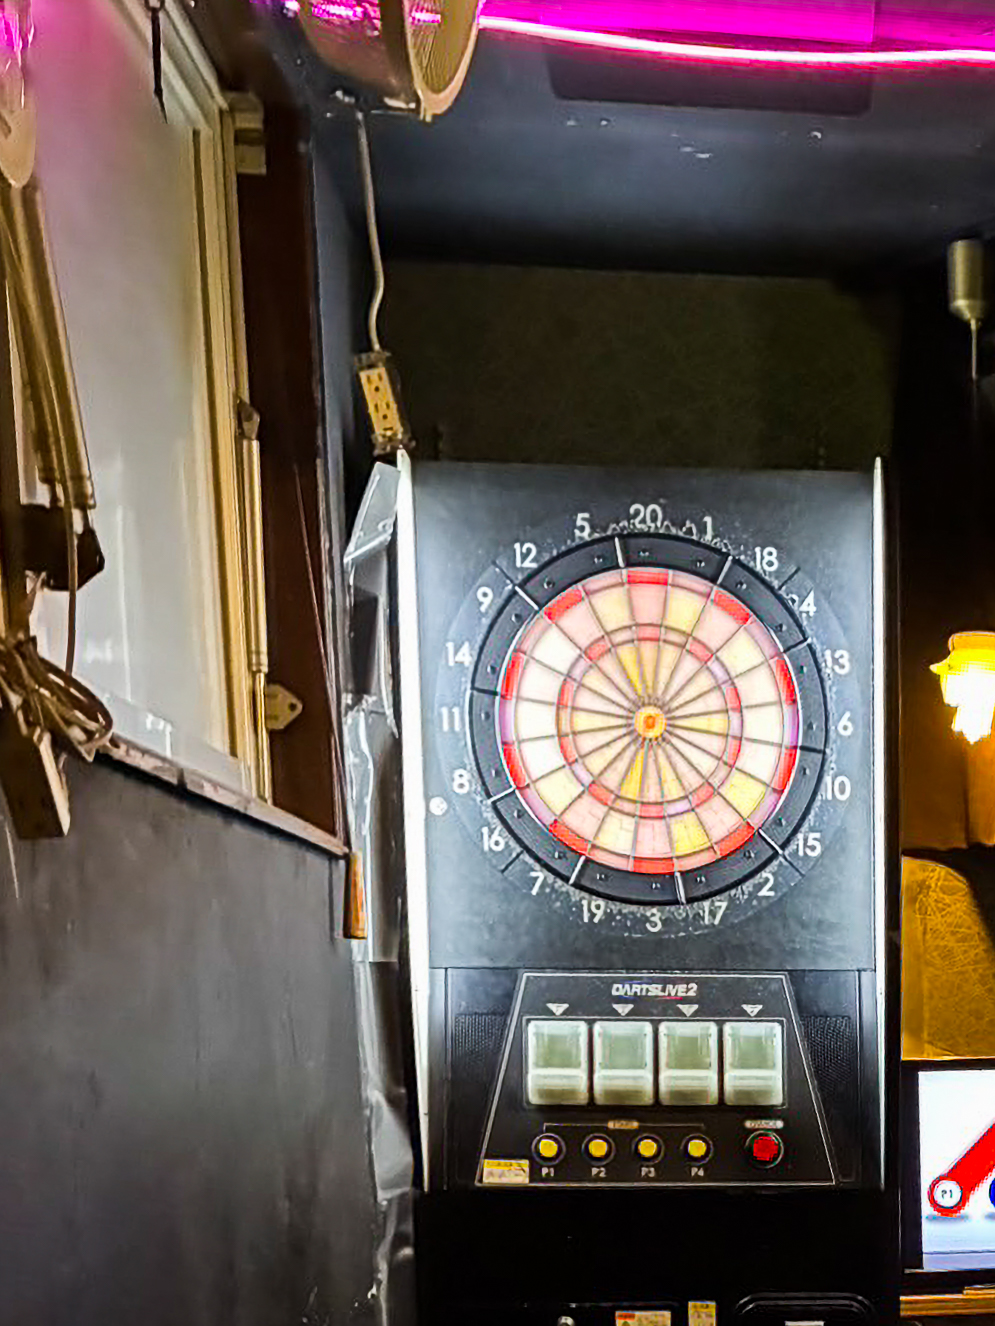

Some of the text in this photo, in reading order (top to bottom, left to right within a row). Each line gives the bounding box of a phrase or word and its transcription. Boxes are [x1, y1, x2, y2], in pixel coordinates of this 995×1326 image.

[574, 512, 591, 539] 5
[629, 503, 663, 530] 20
[702, 515, 713, 541] 1
[514, 543, 537, 568] 12
[755, 547, 778, 571] 18
[476, 587, 494, 611] 9
[799, 589, 817, 617] 4
[446, 642, 471, 667] 14
[827, 650, 850, 674] 13
[441, 708, 461, 731] 11
[838, 714, 853, 736] 6
[452, 770, 469, 794] 8
[826, 778, 851, 801] 10
[482, 828, 505, 852] 16
[797, 833, 821, 857] 15
[530, 873, 545, 895] 7
[758, 875, 775, 897] 2
[582, 899, 605, 923] 19
[645, 909, 662, 932] 3
[704, 901, 728, 926] 17
[611, 982, 698, 996] DARTSLIVE2
[541, 1166, 555, 1178] P1
[591, 1166, 607, 1178] P2
[641, 1166, 655, 1178] P3
[691, 1166, 705, 1178] P4
